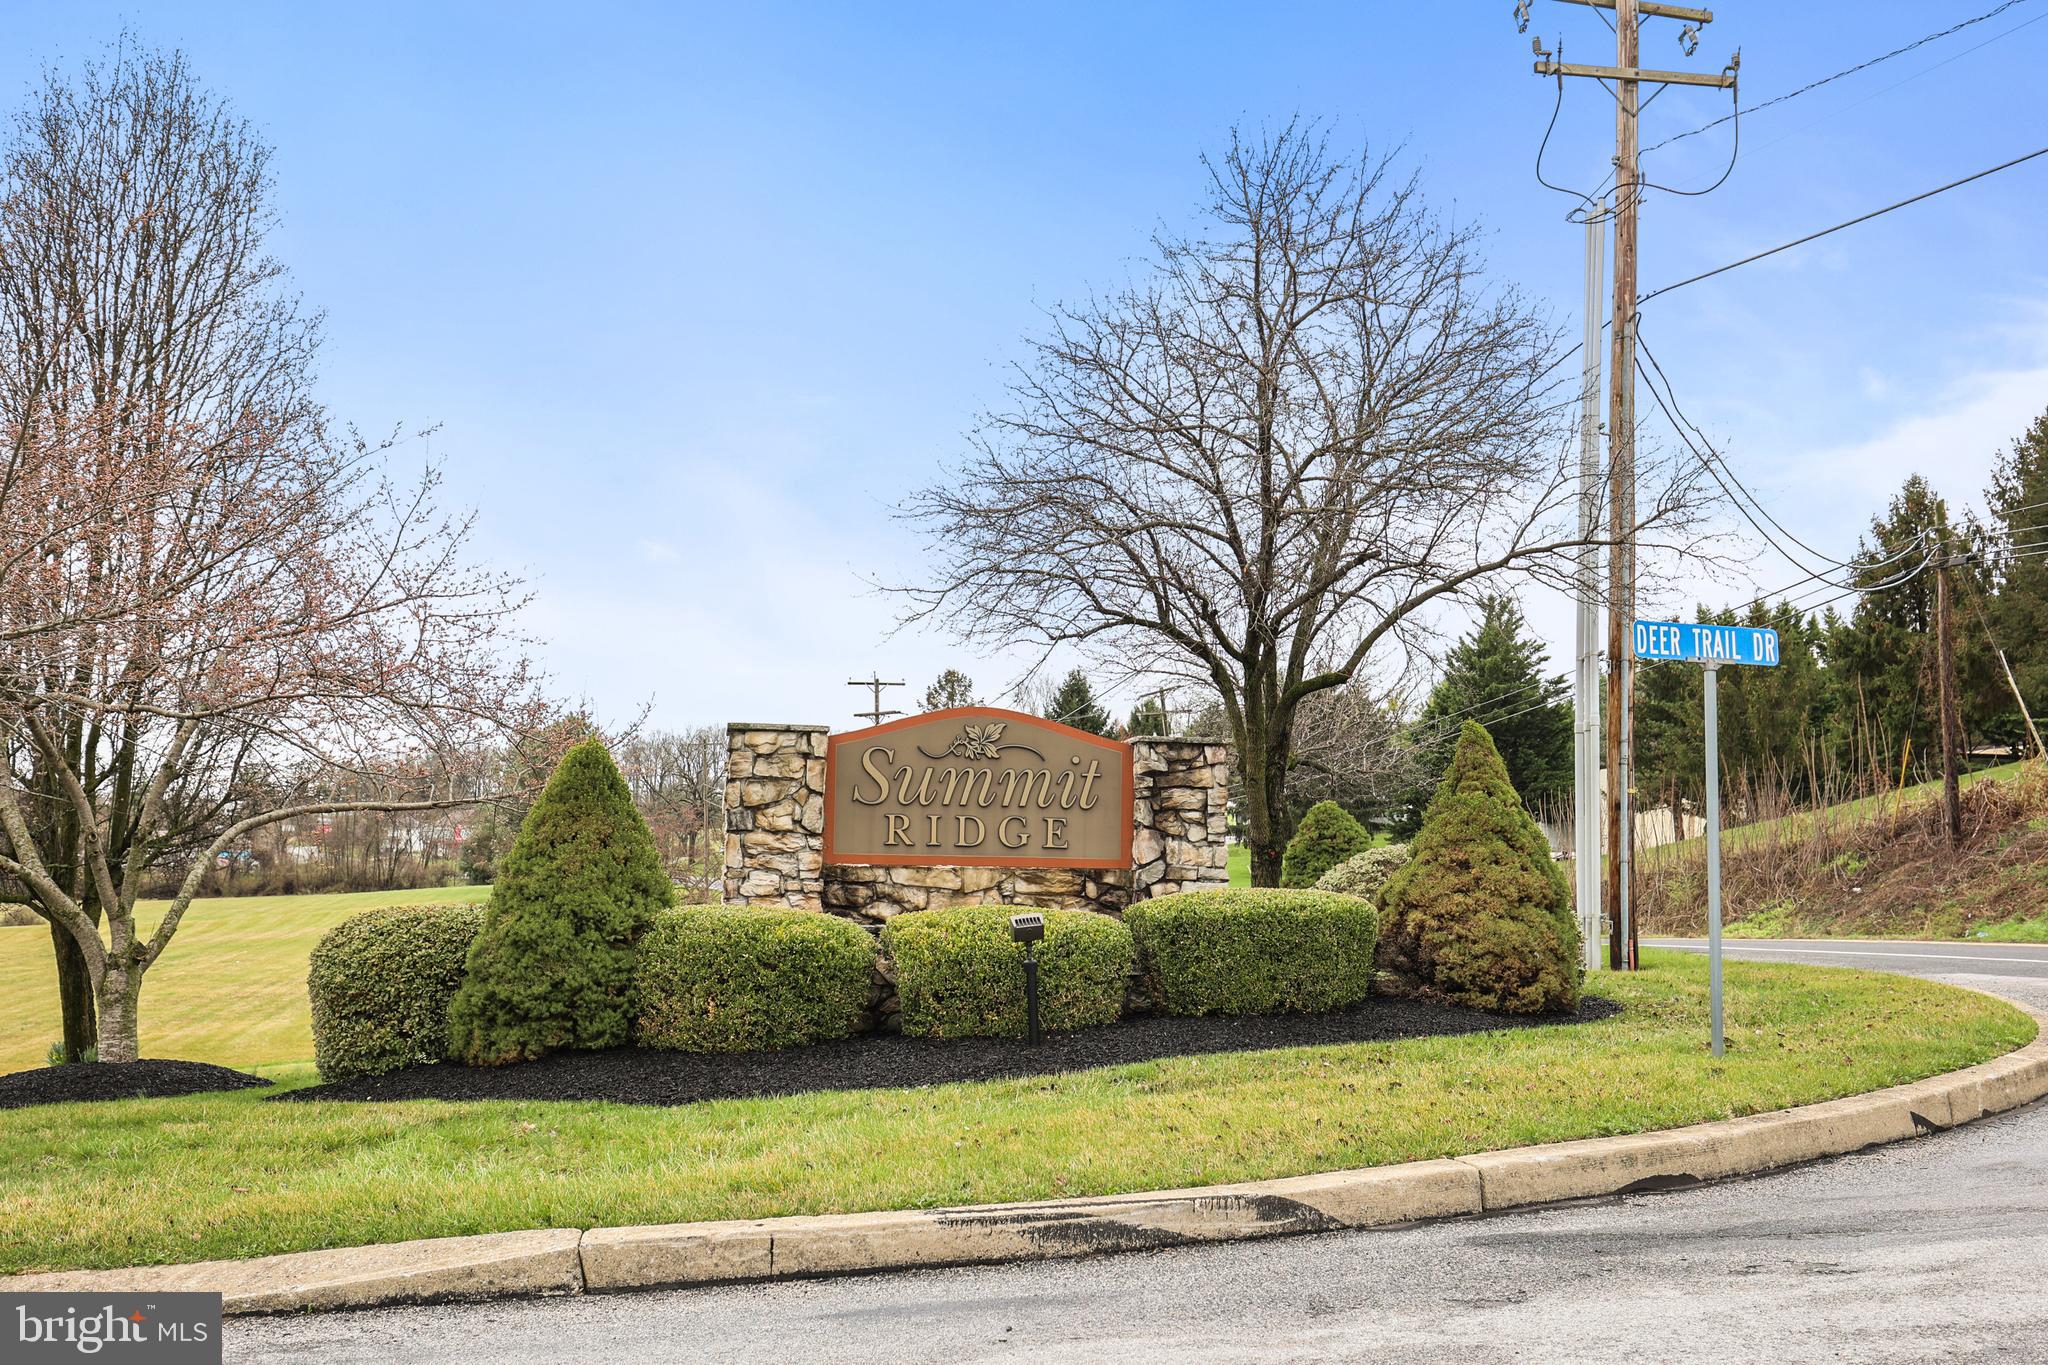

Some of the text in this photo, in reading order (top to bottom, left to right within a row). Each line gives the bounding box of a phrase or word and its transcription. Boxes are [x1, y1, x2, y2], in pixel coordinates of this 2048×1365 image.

[1636, 624, 1775, 662] DEER TRAIL DR
[852, 746, 1101, 810] Summit
[884, 814, 1069, 850] RIDGE
